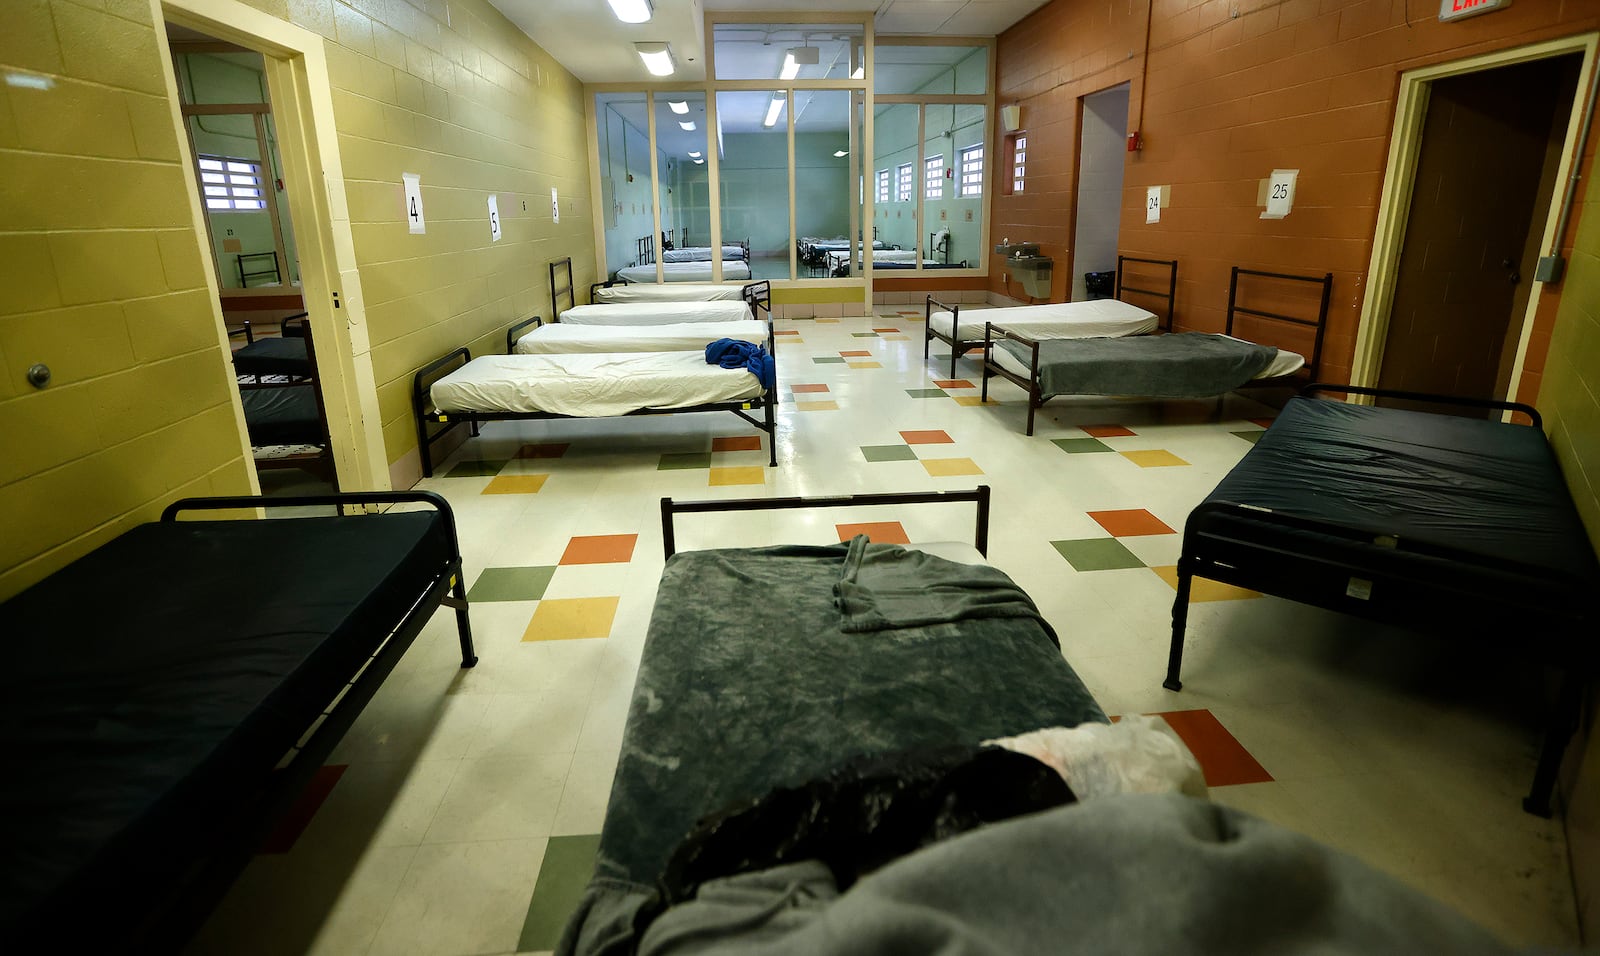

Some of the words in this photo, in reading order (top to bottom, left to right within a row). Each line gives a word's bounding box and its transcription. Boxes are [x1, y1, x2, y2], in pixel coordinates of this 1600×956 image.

[1272, 183, 1289, 200] 25
[410, 196, 419, 223] 4
[1149, 196, 1159, 210] 24
[491, 212, 498, 234] 5
